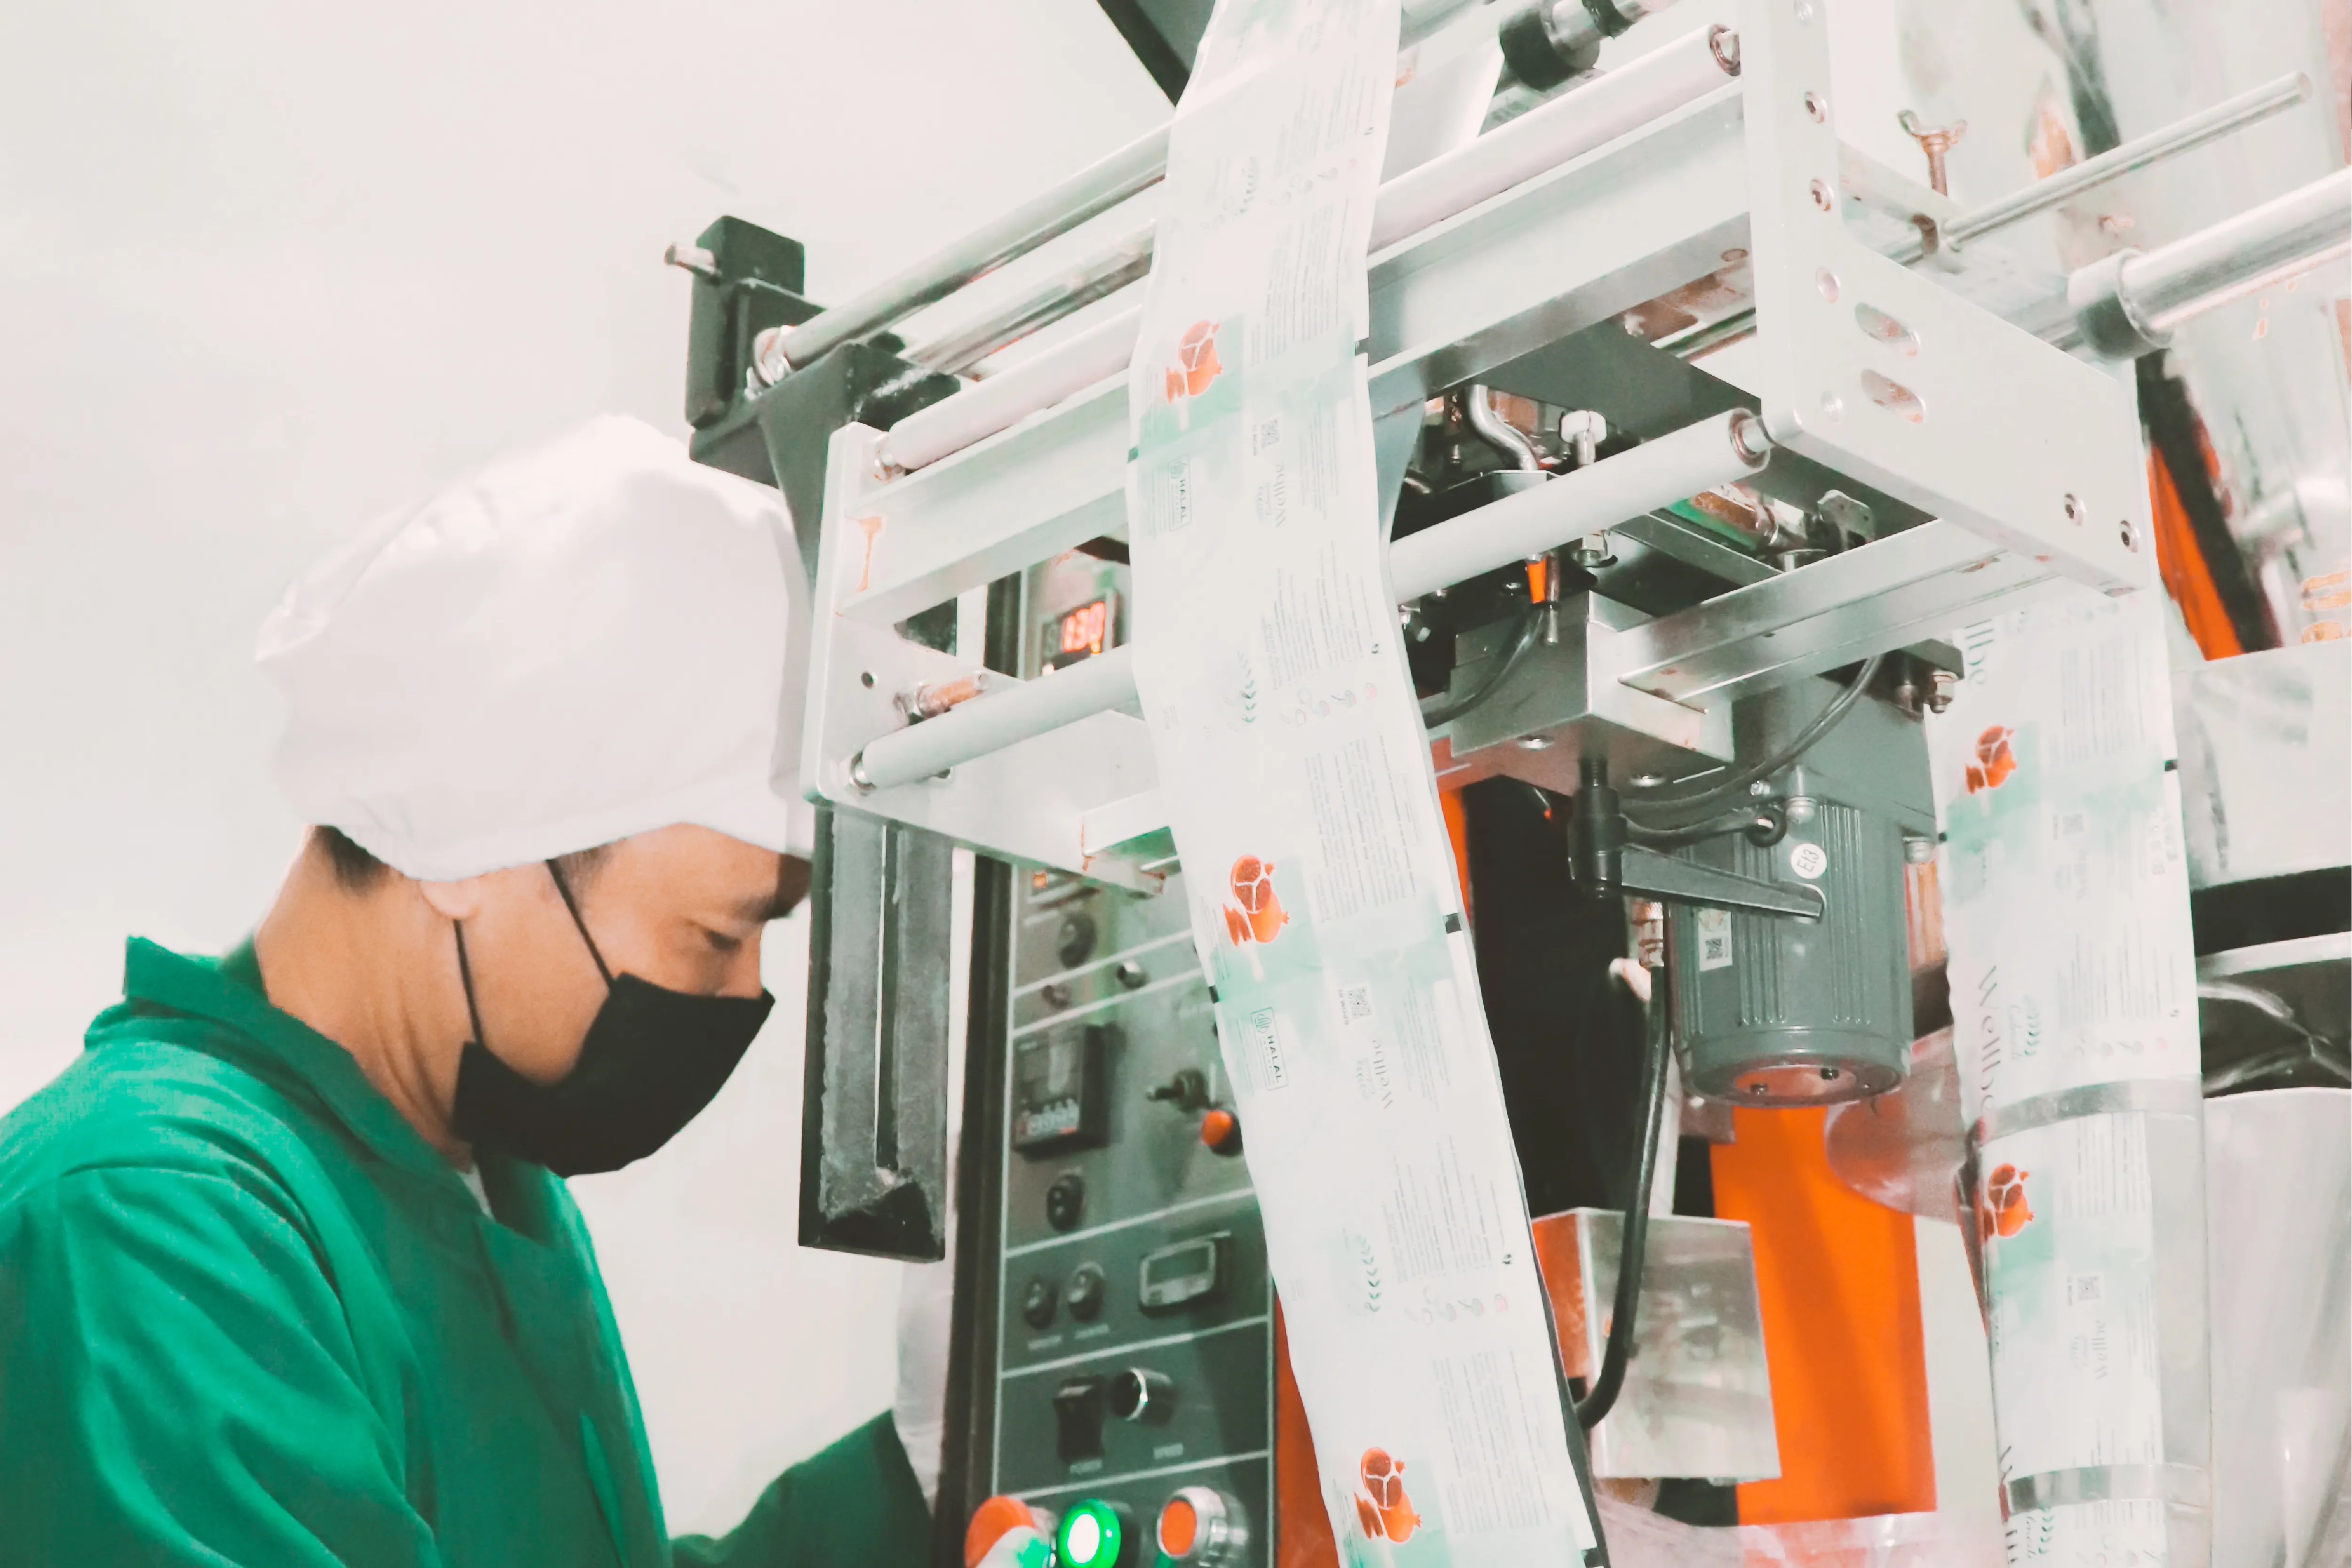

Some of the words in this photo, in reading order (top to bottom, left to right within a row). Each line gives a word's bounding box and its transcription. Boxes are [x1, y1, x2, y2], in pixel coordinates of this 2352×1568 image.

[1180, 479, 1188, 523] HALAL
[1273, 462, 1287, 529] Wellbe
[1267, 1035, 1283, 1084] HALAL
[1371, 1038, 1394, 1110] Wellbe
[2091, 1319, 2108, 1380] Wellbe
